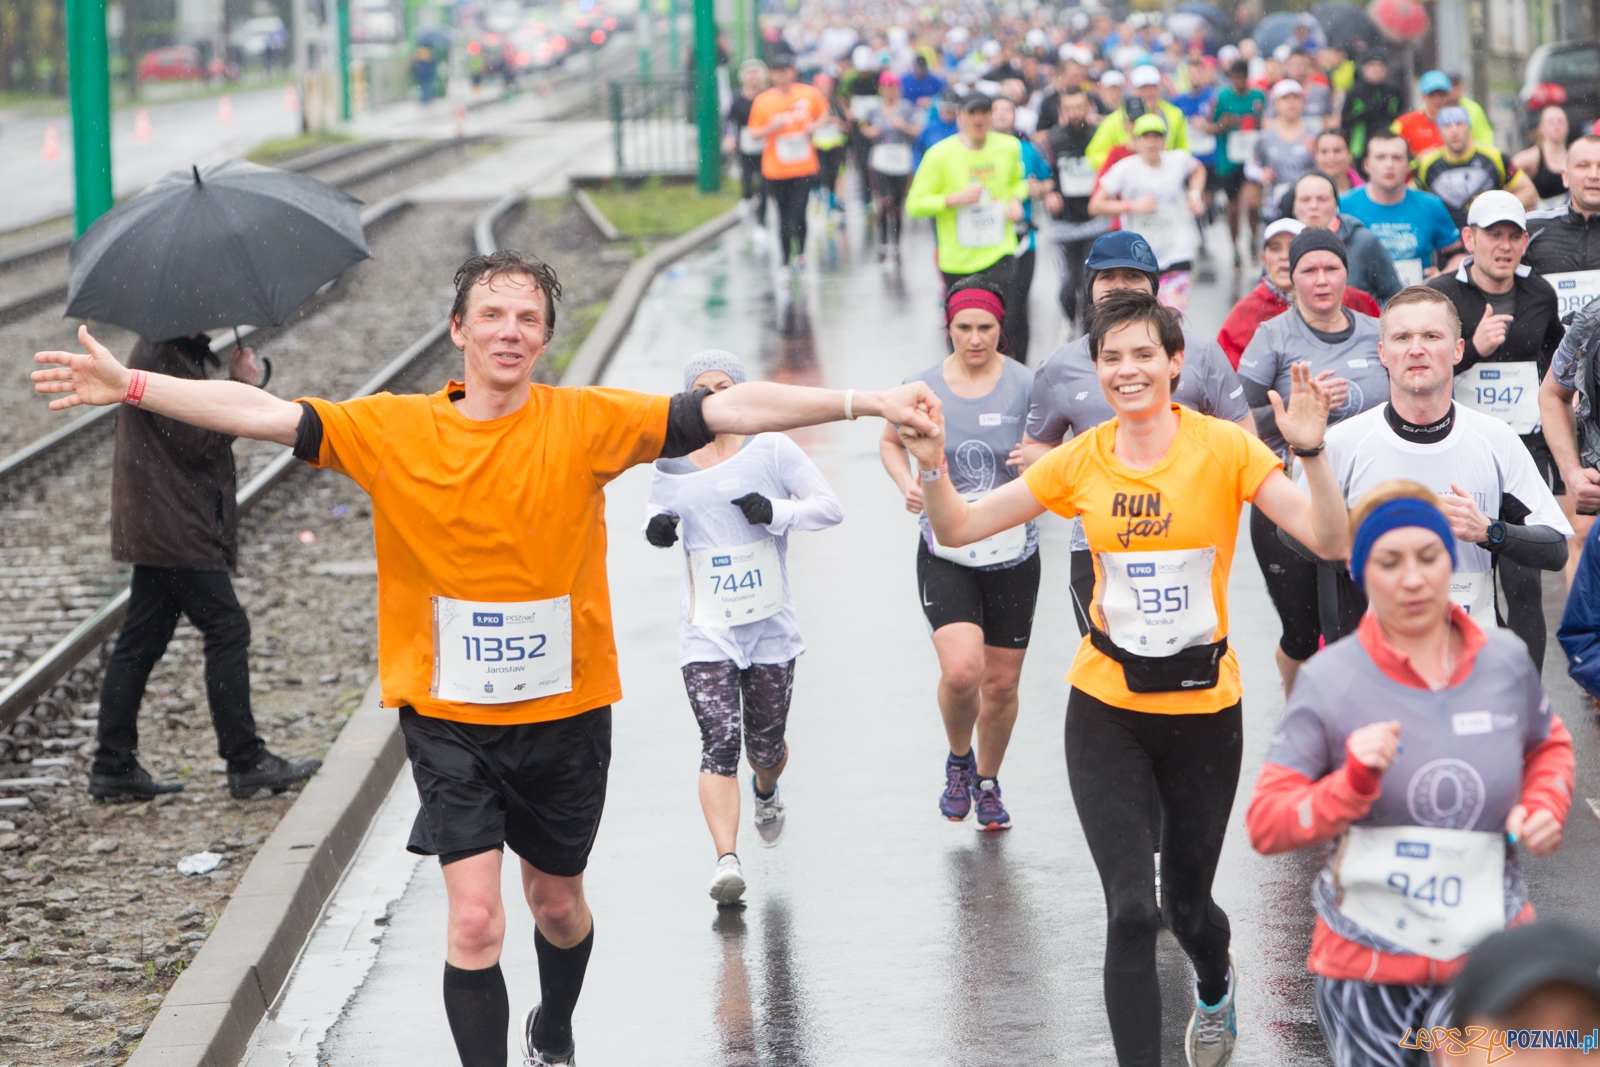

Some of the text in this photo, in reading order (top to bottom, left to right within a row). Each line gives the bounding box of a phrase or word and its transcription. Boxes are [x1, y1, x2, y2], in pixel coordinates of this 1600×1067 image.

[1075, 391, 1089, 401] 4F
[1475, 386, 1524, 405] 1947
[1111, 492, 1161, 518] RUN
[1117, 512, 1173, 549] fast
[710, 568, 762, 594] 7441
[476, 616, 500, 625] 9.PKO
[462, 633, 547, 661] 11352
[485, 665, 526, 674] Jarosław
